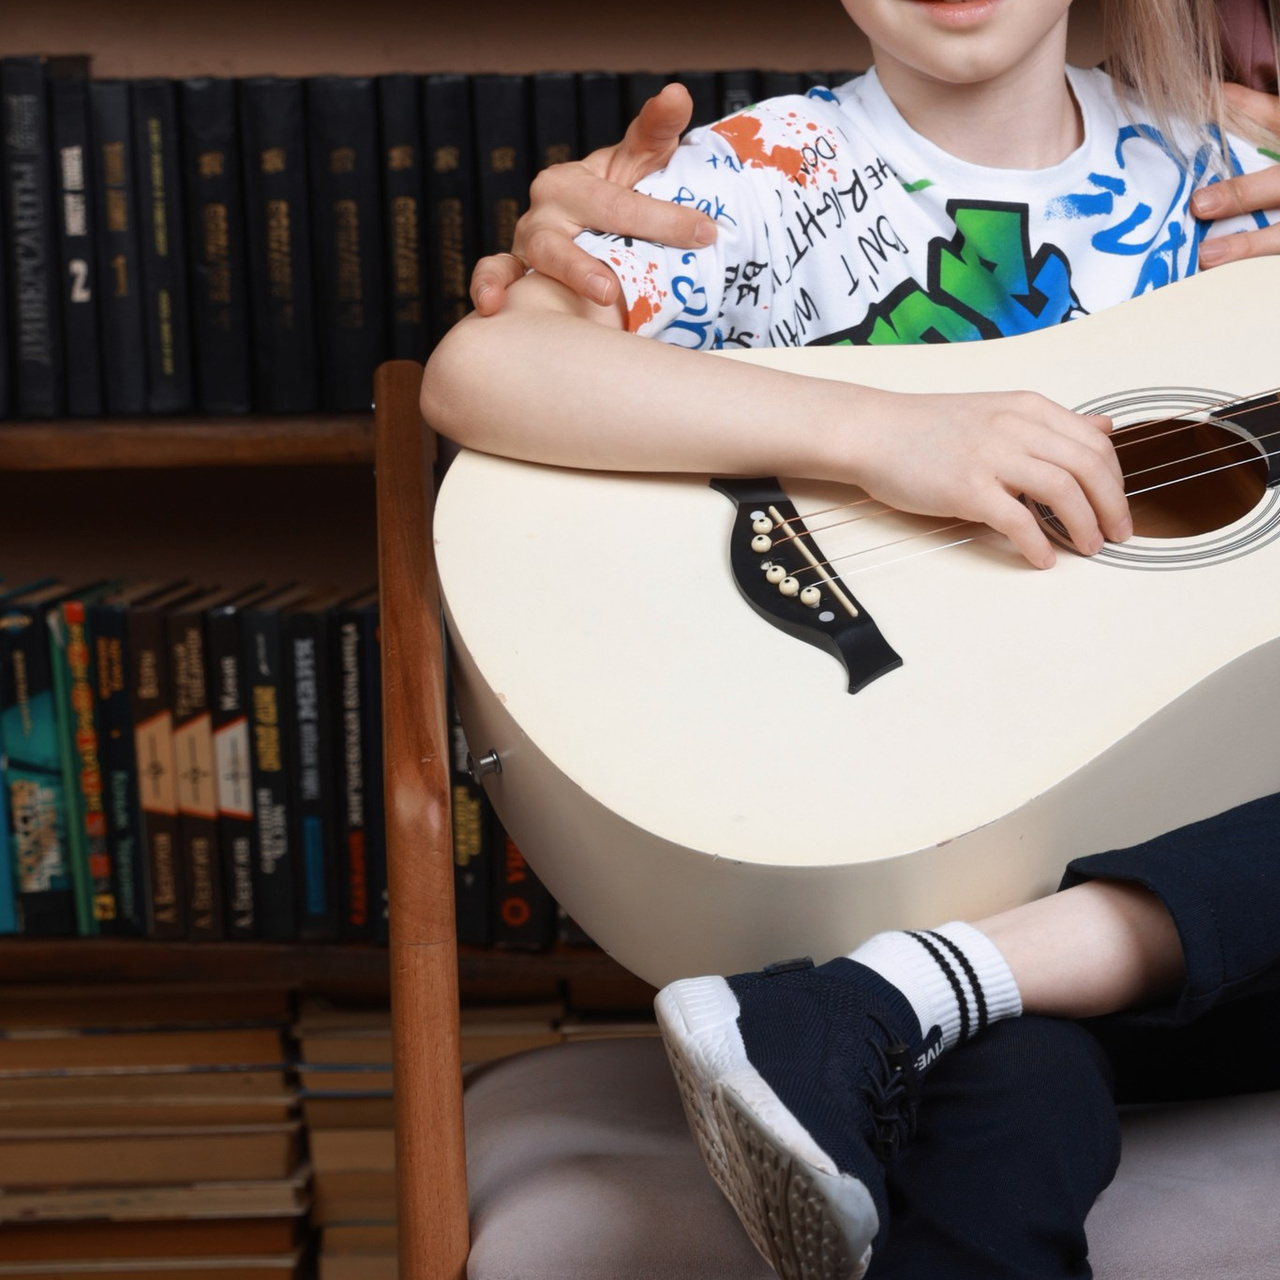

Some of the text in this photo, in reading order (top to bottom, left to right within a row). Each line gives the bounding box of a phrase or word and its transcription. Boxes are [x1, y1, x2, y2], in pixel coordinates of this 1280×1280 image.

[11, 162, 50, 366] ДИВЕРСАНТЫ
[67, 258, 91, 305] 2
[108, 254, 127, 299] 1
